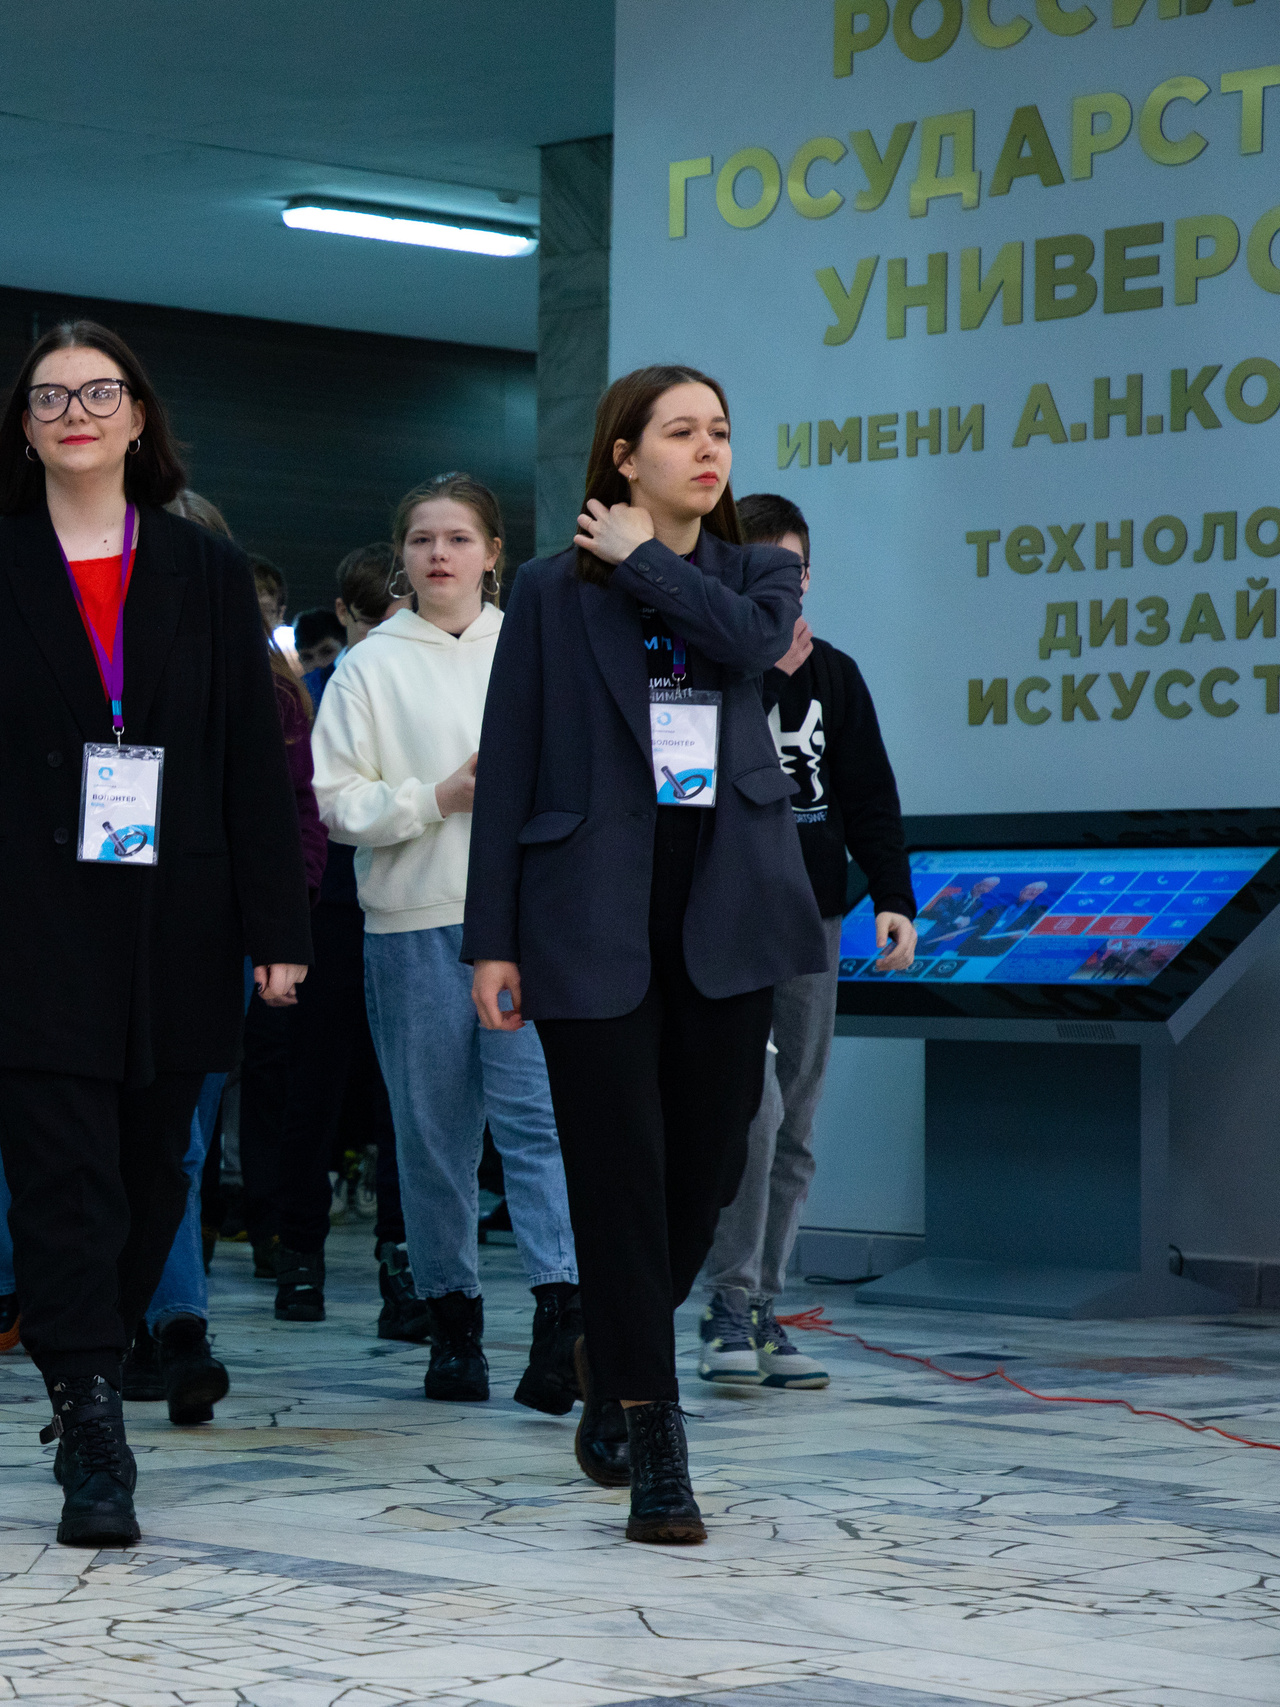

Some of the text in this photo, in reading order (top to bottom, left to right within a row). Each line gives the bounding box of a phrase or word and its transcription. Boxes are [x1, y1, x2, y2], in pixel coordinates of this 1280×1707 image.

[832, 0, 1257, 79] РОС
[668, 65, 1280, 240] ГОСУДАРСТ
[776, 403, 985, 470] ИМЕНИ
